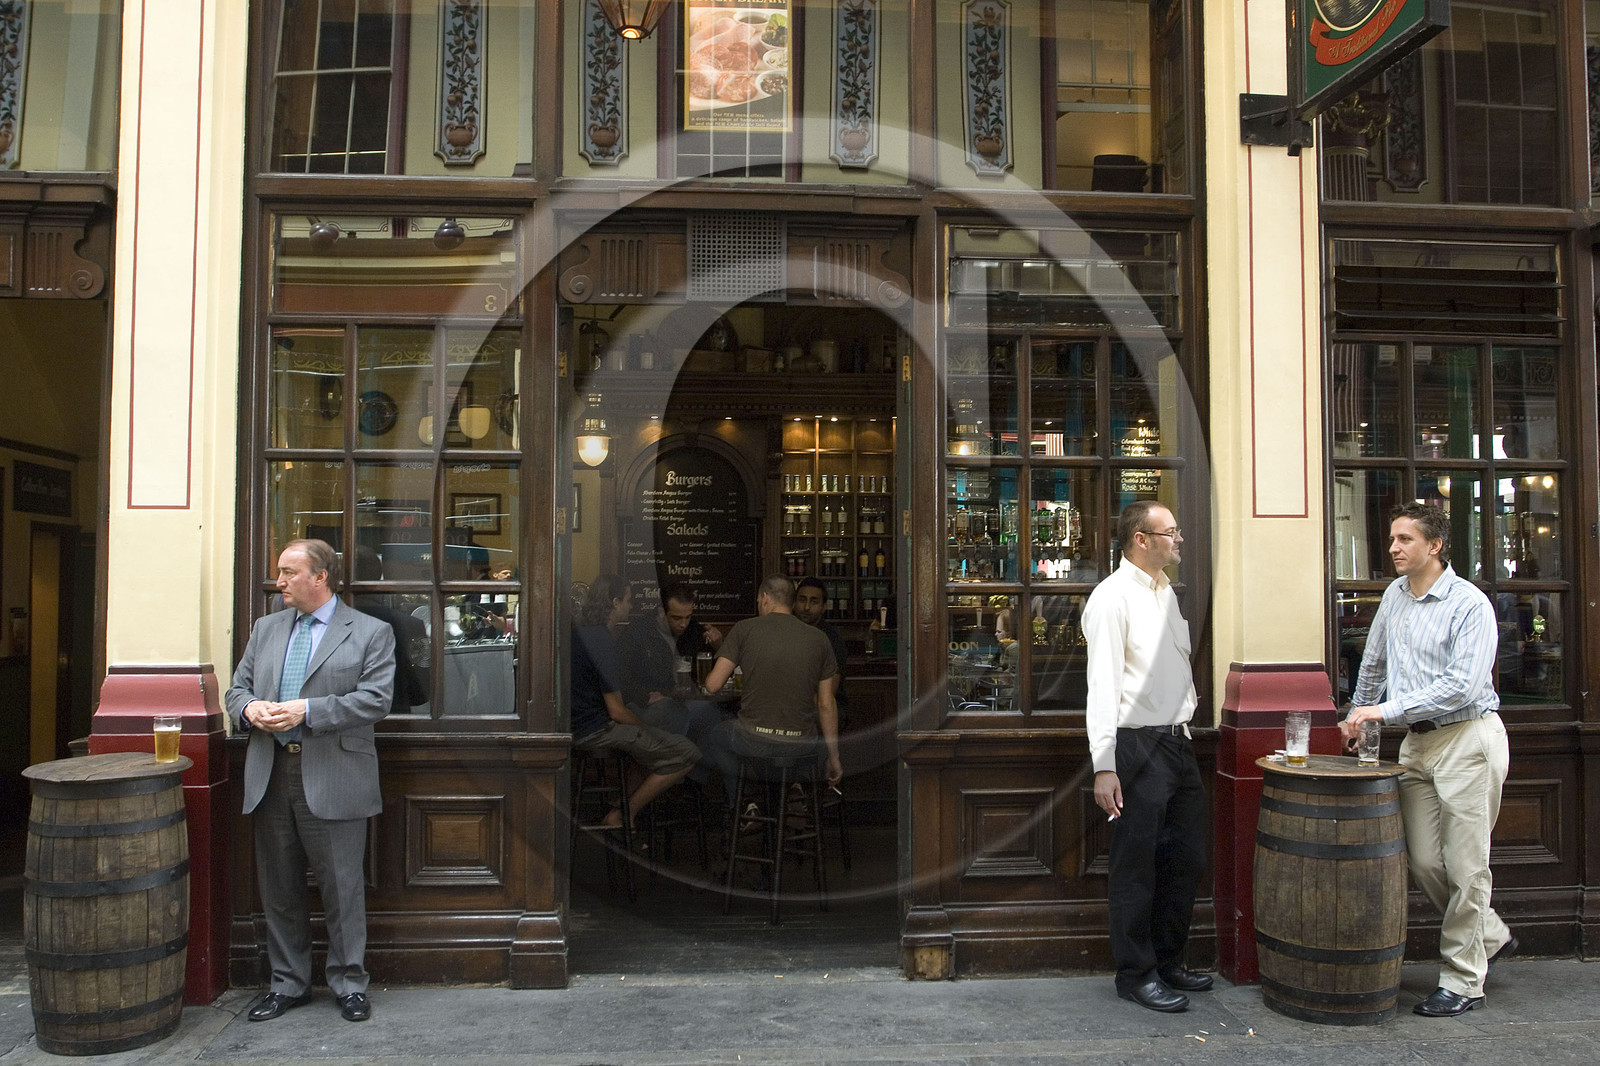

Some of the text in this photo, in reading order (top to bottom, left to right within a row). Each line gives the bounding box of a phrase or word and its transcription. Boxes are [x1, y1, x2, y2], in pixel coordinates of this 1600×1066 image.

[665, 470, 713, 488] Burgers
[666, 523, 709, 536] Salads
[667, 564, 703, 577] Wraps
[699, 602, 720, 611] Orders
